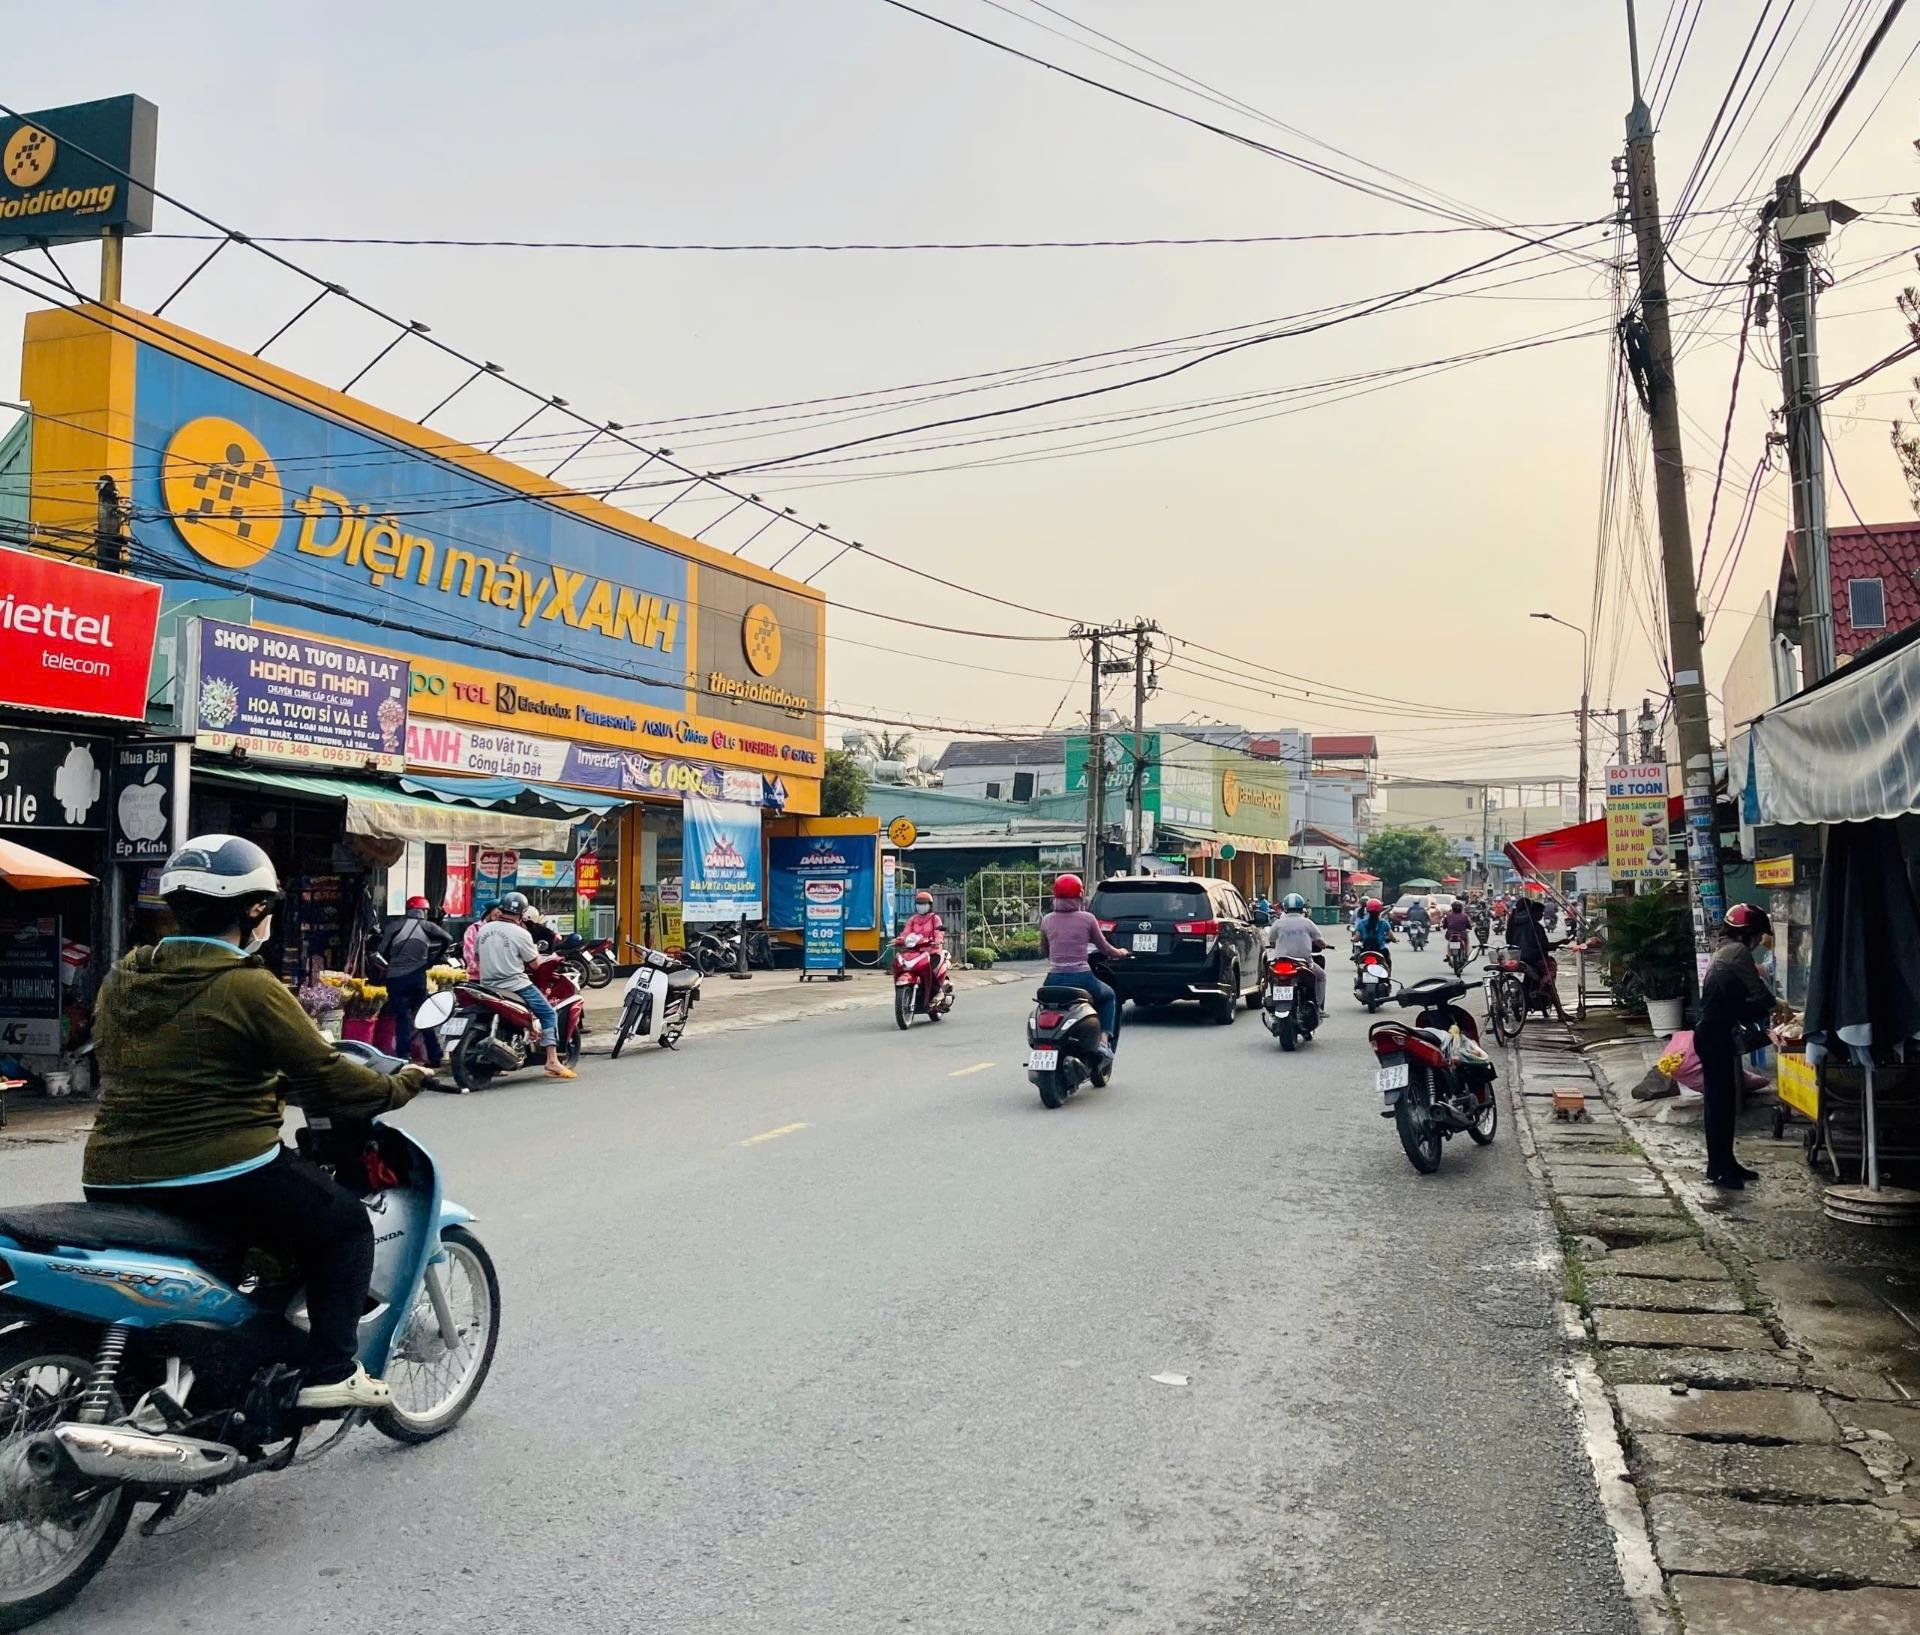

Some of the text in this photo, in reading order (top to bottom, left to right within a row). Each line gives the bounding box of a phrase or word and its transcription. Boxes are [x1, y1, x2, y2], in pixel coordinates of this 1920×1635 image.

[292, 485, 435, 586] Điện
[42, 650, 110, 676] telecom
[214, 628, 259, 653] SHOP
[263, 638, 300, 662] HOA
[346, 656, 367, 675] ĐÀ
[371, 661, 399, 682] LẠT
[250, 659, 316, 687] HOÀNG
[248, 697, 368, 728] HOA TƯƠI SỈ VÀ LẺ
[453, 681, 490, 705] TCL
[518, 696, 571, 719] Electrolux
[577, 705, 637, 731] Panasonic
[642, 720, 674, 738] AQUA
[739, 738, 778, 757] TOSHIBA
[241, 714, 263, 724] NHẬN
[284, 719, 298, 729] CÁC
[299, 723, 316, 732] LOẠI
[318, 725, 333, 734] HOA
[335, 728, 352, 736] THEO
[249, 727, 268, 736] SINH
[294, 733, 312, 742] KHAI
[236, 737, 263, 750] 0981
[267, 741, 284, 753] 176
[289, 744, 309, 756] 348
[322, 748, 351, 761] 0965
[471, 734, 493, 751] Bao
[496, 737, 514, 756] Vật
[517, 741, 532, 756] Tư
[120, 749, 168, 765] Mua Bán
[468, 754, 497, 774] Công
[500, 757, 520, 777] Lắp
[577, 749, 620, 769] Inverter
[1611, 766, 1660, 779] BÒ TƯƠI
[117, 839, 167, 856] Ép Kính
[3, 1023, 27, 1045] 4G
